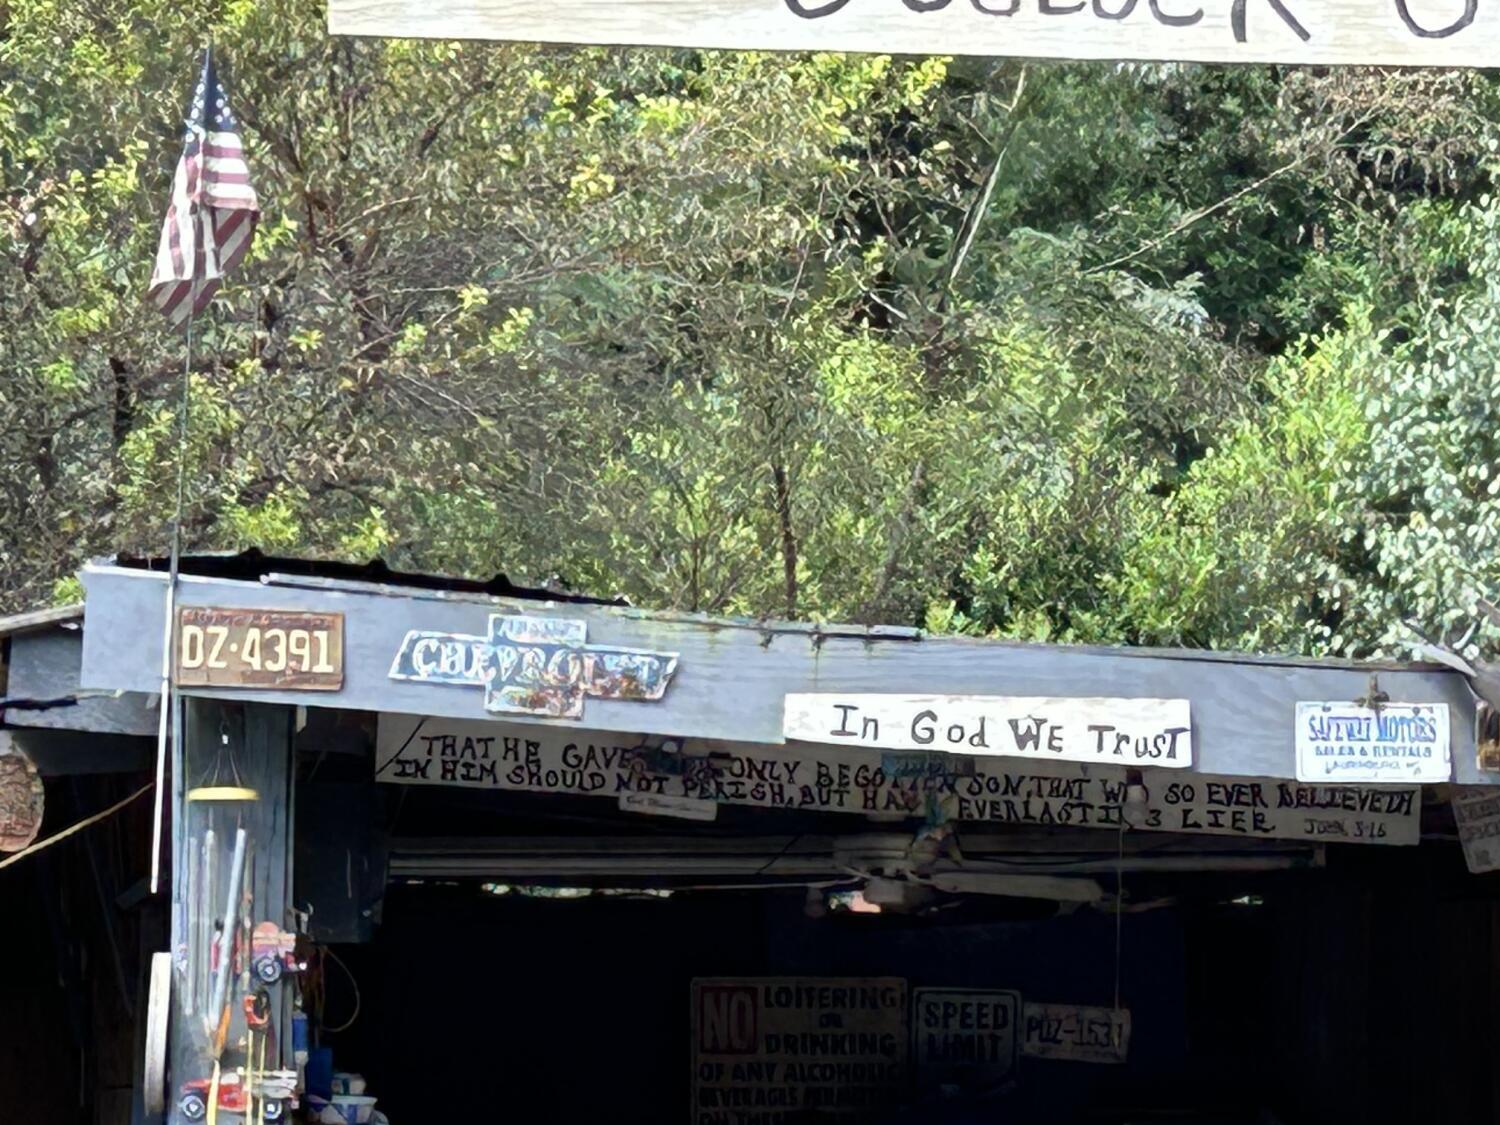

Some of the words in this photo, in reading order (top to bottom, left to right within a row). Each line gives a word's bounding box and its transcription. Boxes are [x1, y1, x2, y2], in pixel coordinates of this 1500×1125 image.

[829, 704, 879, 741] In
[911, 709, 989, 748] God
[420, 735, 496, 760] THAT
[502, 736, 542, 765] HE
[561, 743, 633, 771] GAVE
[731, 757, 799, 784] ONLY
[394, 758, 430, 780] IN
[441, 758, 498, 785] HIM
[506, 763, 606, 790] SHOULD
[615, 772, 670, 795] NOT
[799, 784, 852, 807] BUT
[958, 798, 1163, 827] EVERLASTI
[764, 985, 898, 1010] LOITERING
[703, 990, 755, 1051] NO
[925, 1000, 1009, 1030] SPEED
[764, 1032, 897, 1056] DRINKING
[927, 1033, 1005, 1064] LIMIT
[731, 1062, 777, 1082] ANY
